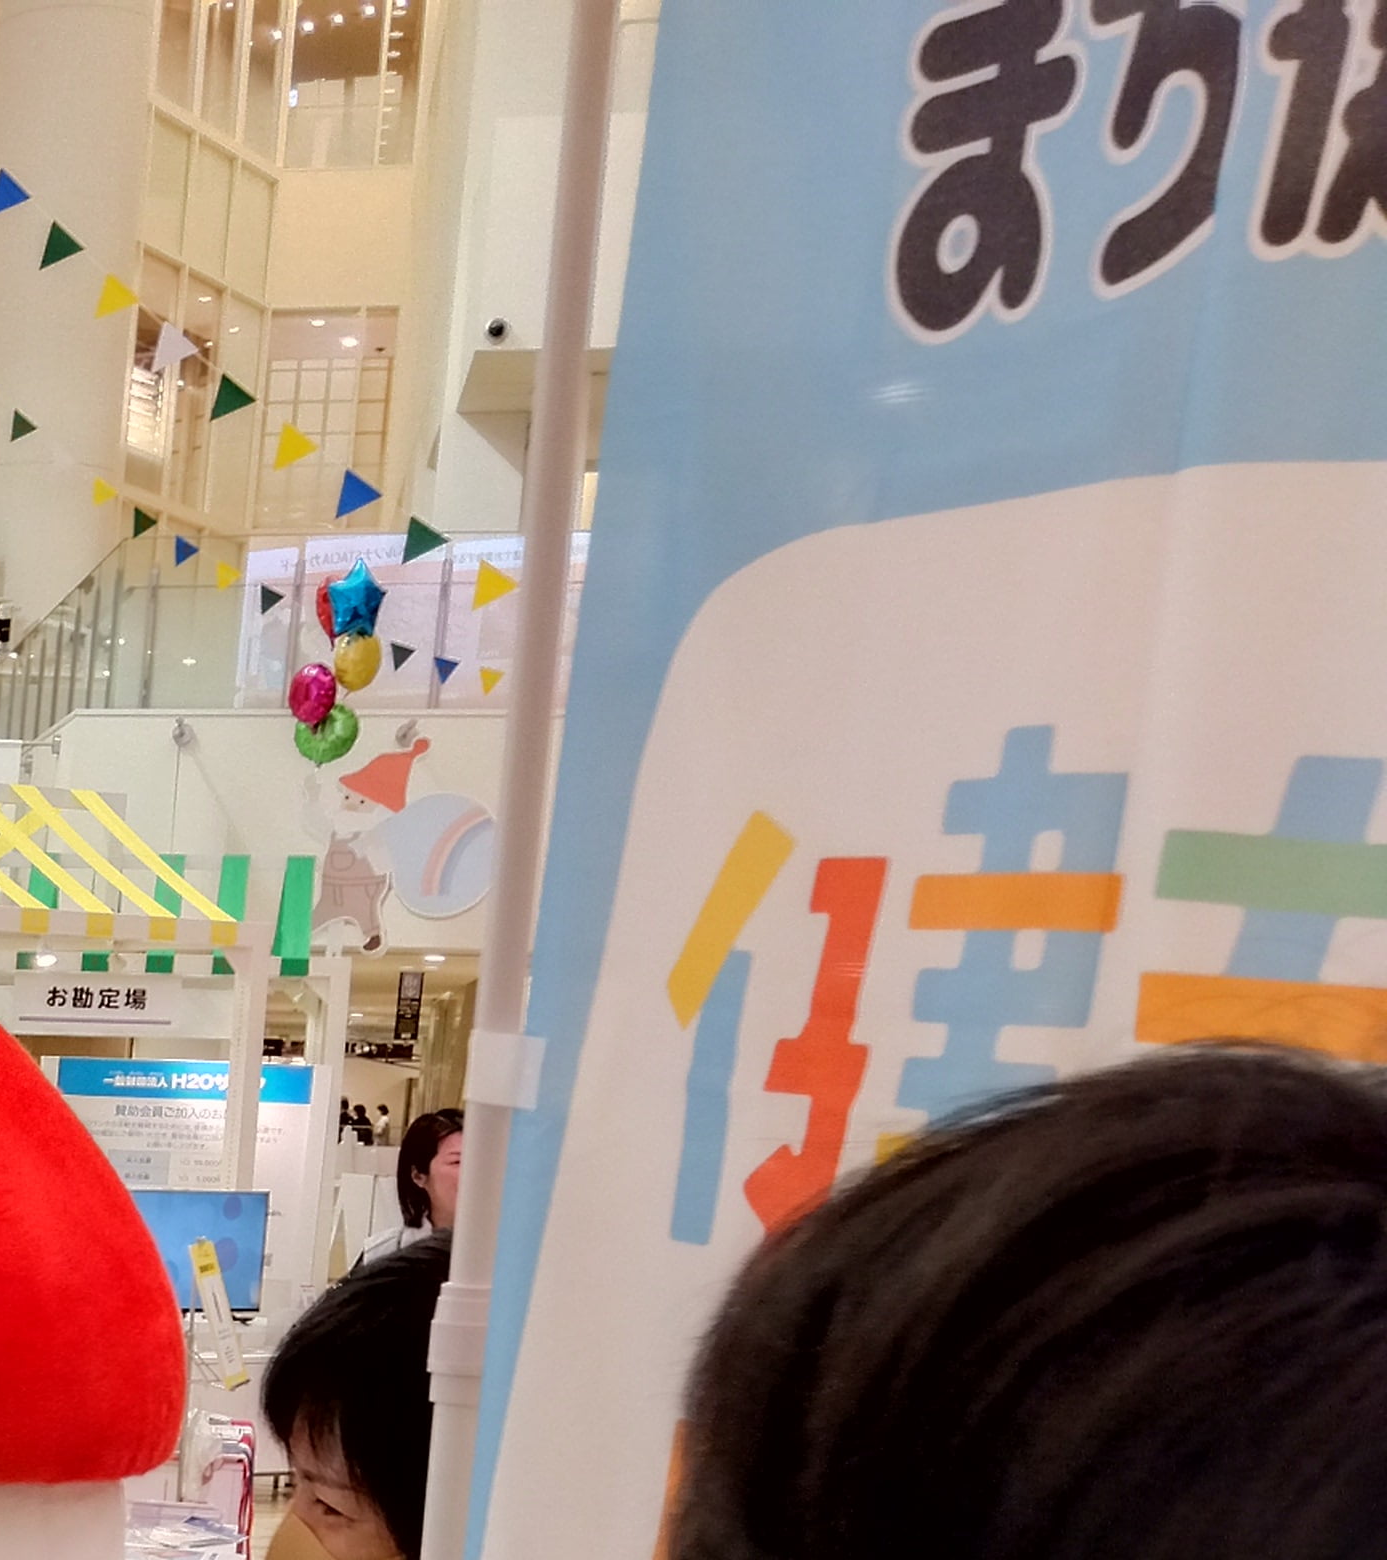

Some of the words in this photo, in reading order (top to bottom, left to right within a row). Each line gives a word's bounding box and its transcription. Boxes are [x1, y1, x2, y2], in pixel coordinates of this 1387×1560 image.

[45, 985, 148, 1011] お勘定場
[114, 1104, 228, 1121] 賛助会員ご加入のお
